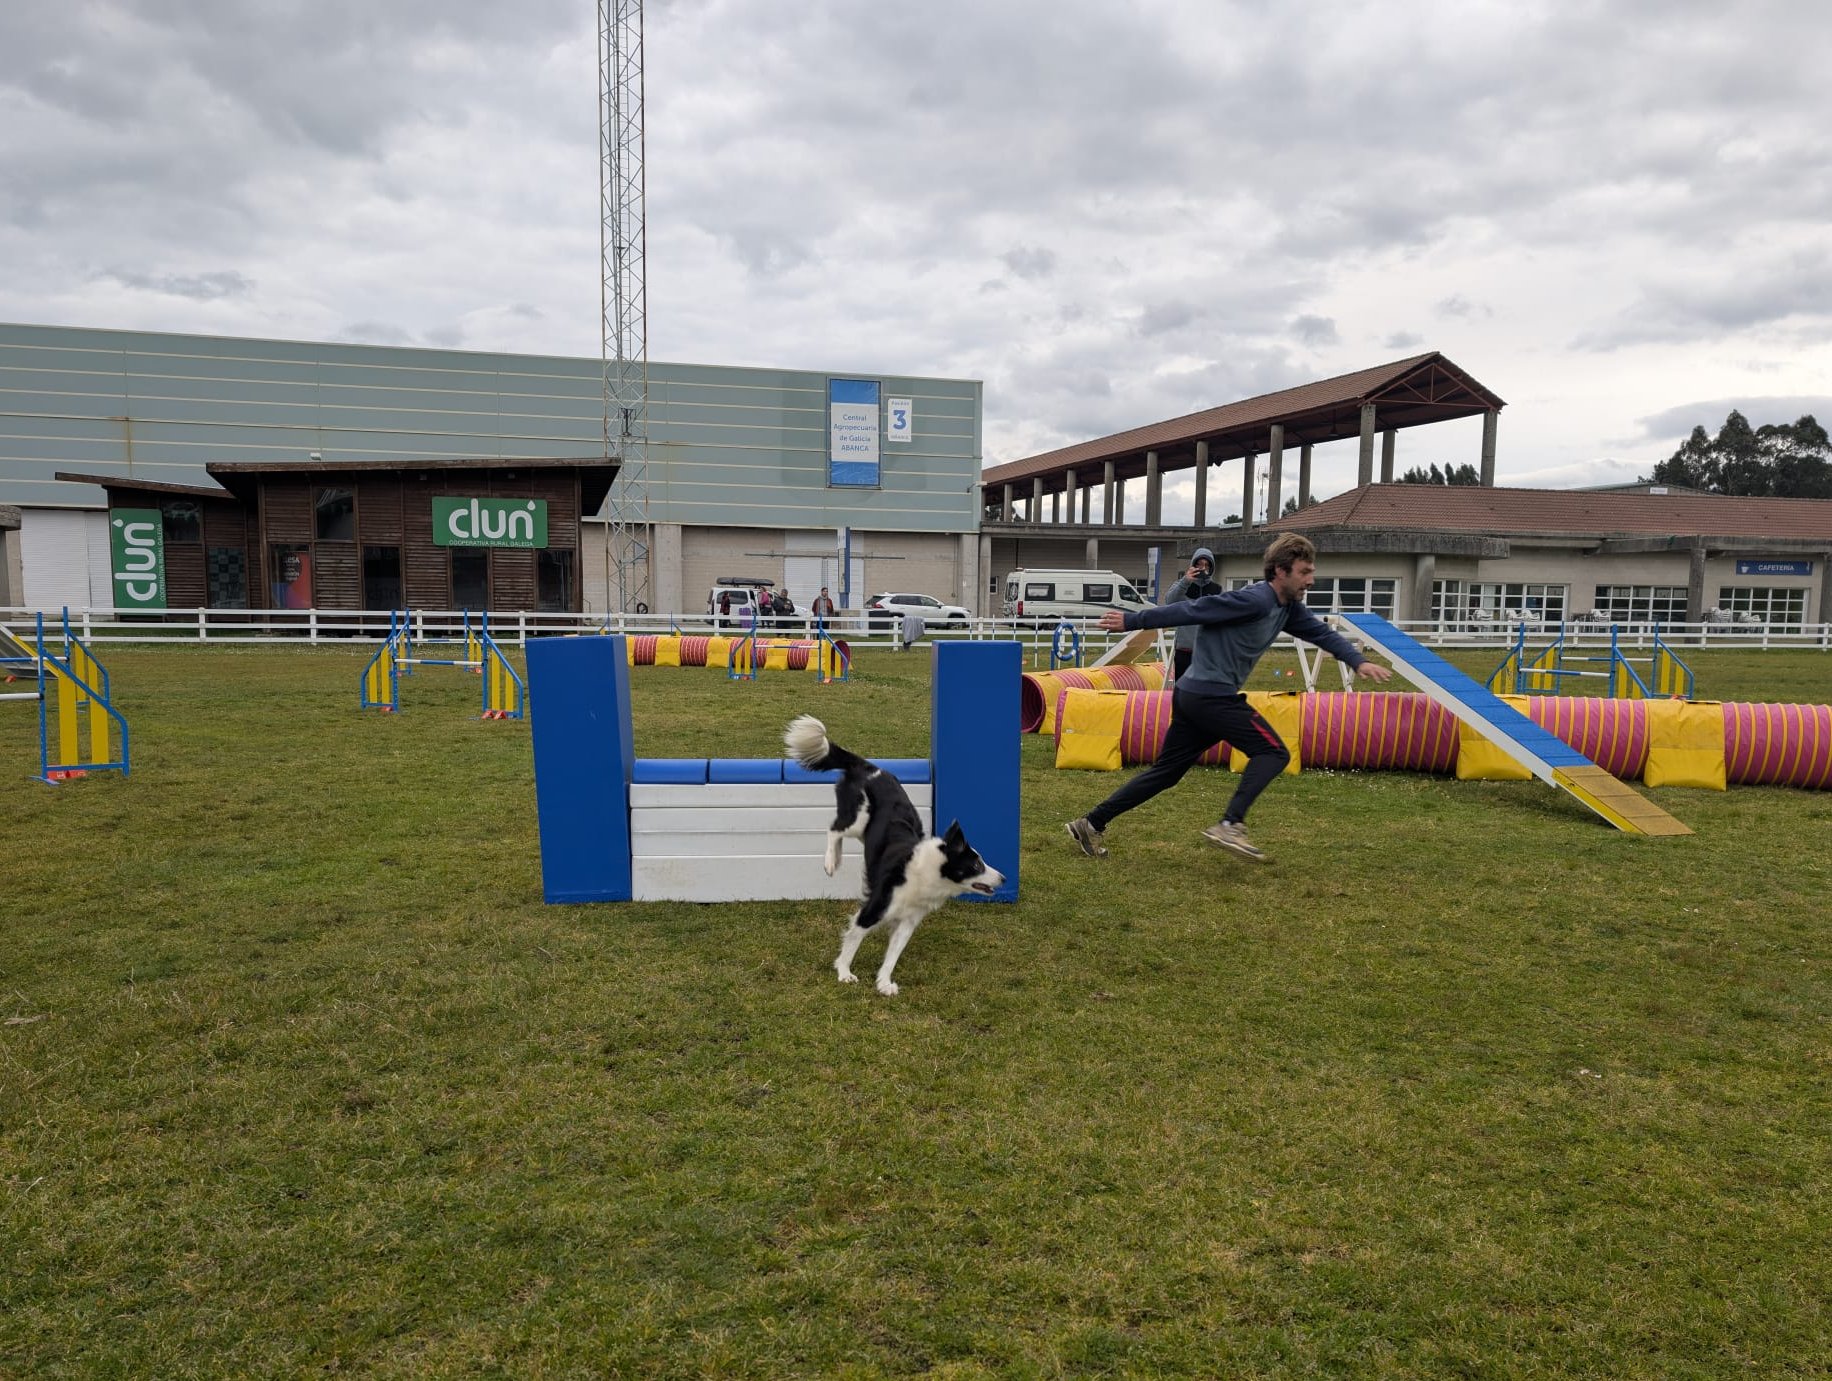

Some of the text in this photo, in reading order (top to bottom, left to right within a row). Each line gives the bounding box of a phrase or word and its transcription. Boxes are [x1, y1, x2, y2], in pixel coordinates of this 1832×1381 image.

[842, 414, 867, 422] Central
[893, 410, 906, 430] 3
[849, 434, 870, 442] Galicia
[841, 444, 869, 452] ABANCA
[449, 498, 533, 539] clun
[114, 522, 157, 601] clun
